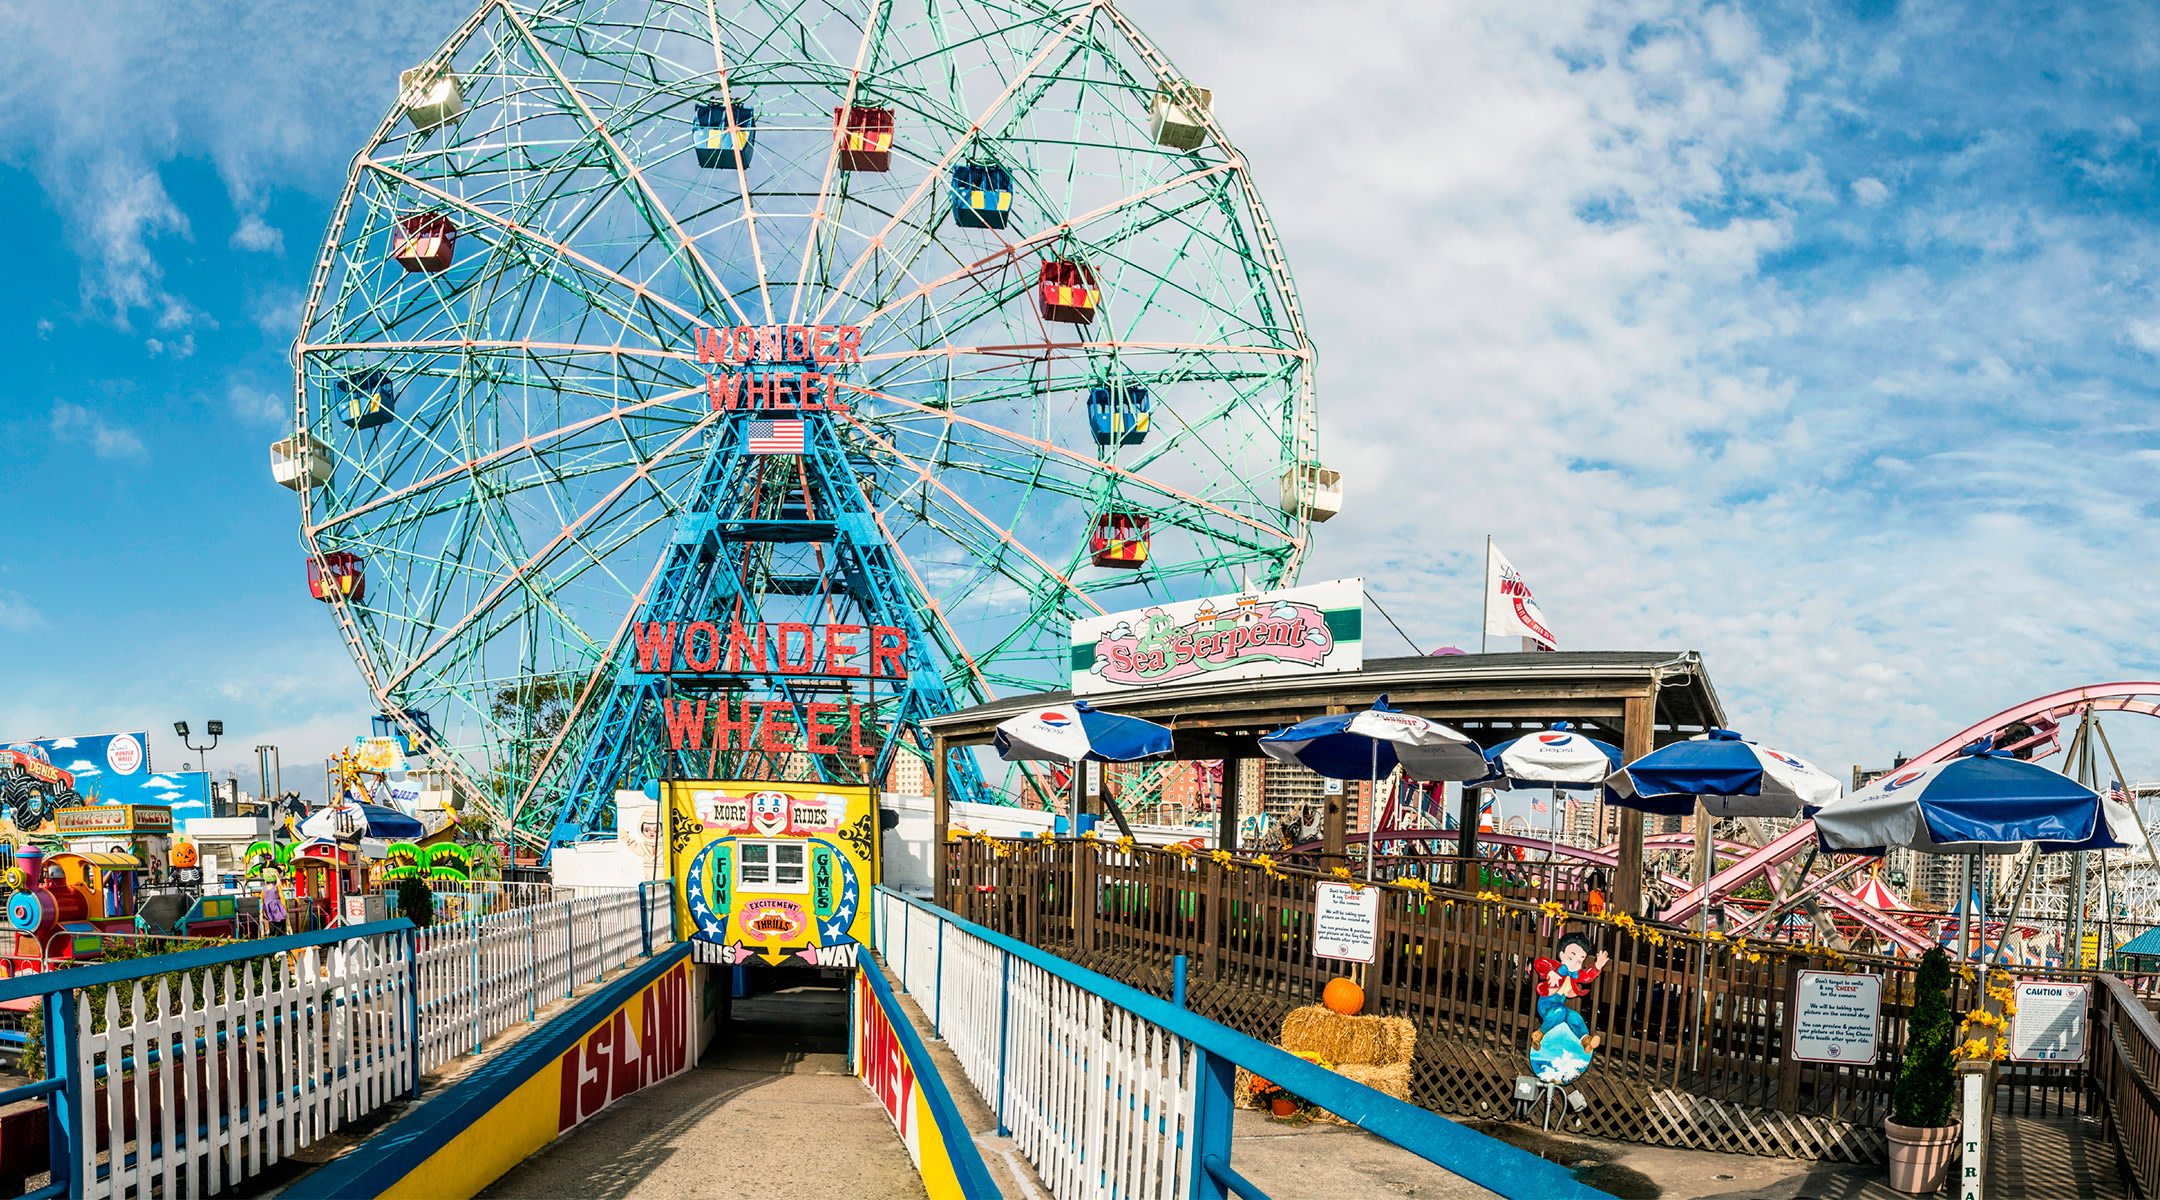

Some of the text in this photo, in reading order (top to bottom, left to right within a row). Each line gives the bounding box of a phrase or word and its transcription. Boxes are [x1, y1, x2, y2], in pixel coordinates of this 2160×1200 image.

[693, 325, 861, 363] WONDER
[706, 373, 850, 411] WHEEL
[634, 621, 908, 678] WONDER
[1112, 618, 1307, 672] Sea Serpent
[664, 700, 876, 755] WHEEL
[392, 788, 419, 801] SHIP
[64, 812, 121, 826] TICKETS
[137, 810, 169, 824] TICKETS
[714, 805, 746, 821] MORE
[794, 807, 827, 825] RIDES
[717, 858, 727, 904] FUN
[817, 854, 829, 908] GAMES
[749, 901, 798, 911] EXCITEMENT
[756, 919, 790, 931] THRILLS
[692, 939, 736, 964] THIS
[815, 943, 860, 967] WAY
[2026, 988, 2062, 996] CAUTION
[559, 962, 690, 1133] ISLAND
[861, 970, 916, 1140] CONEY
